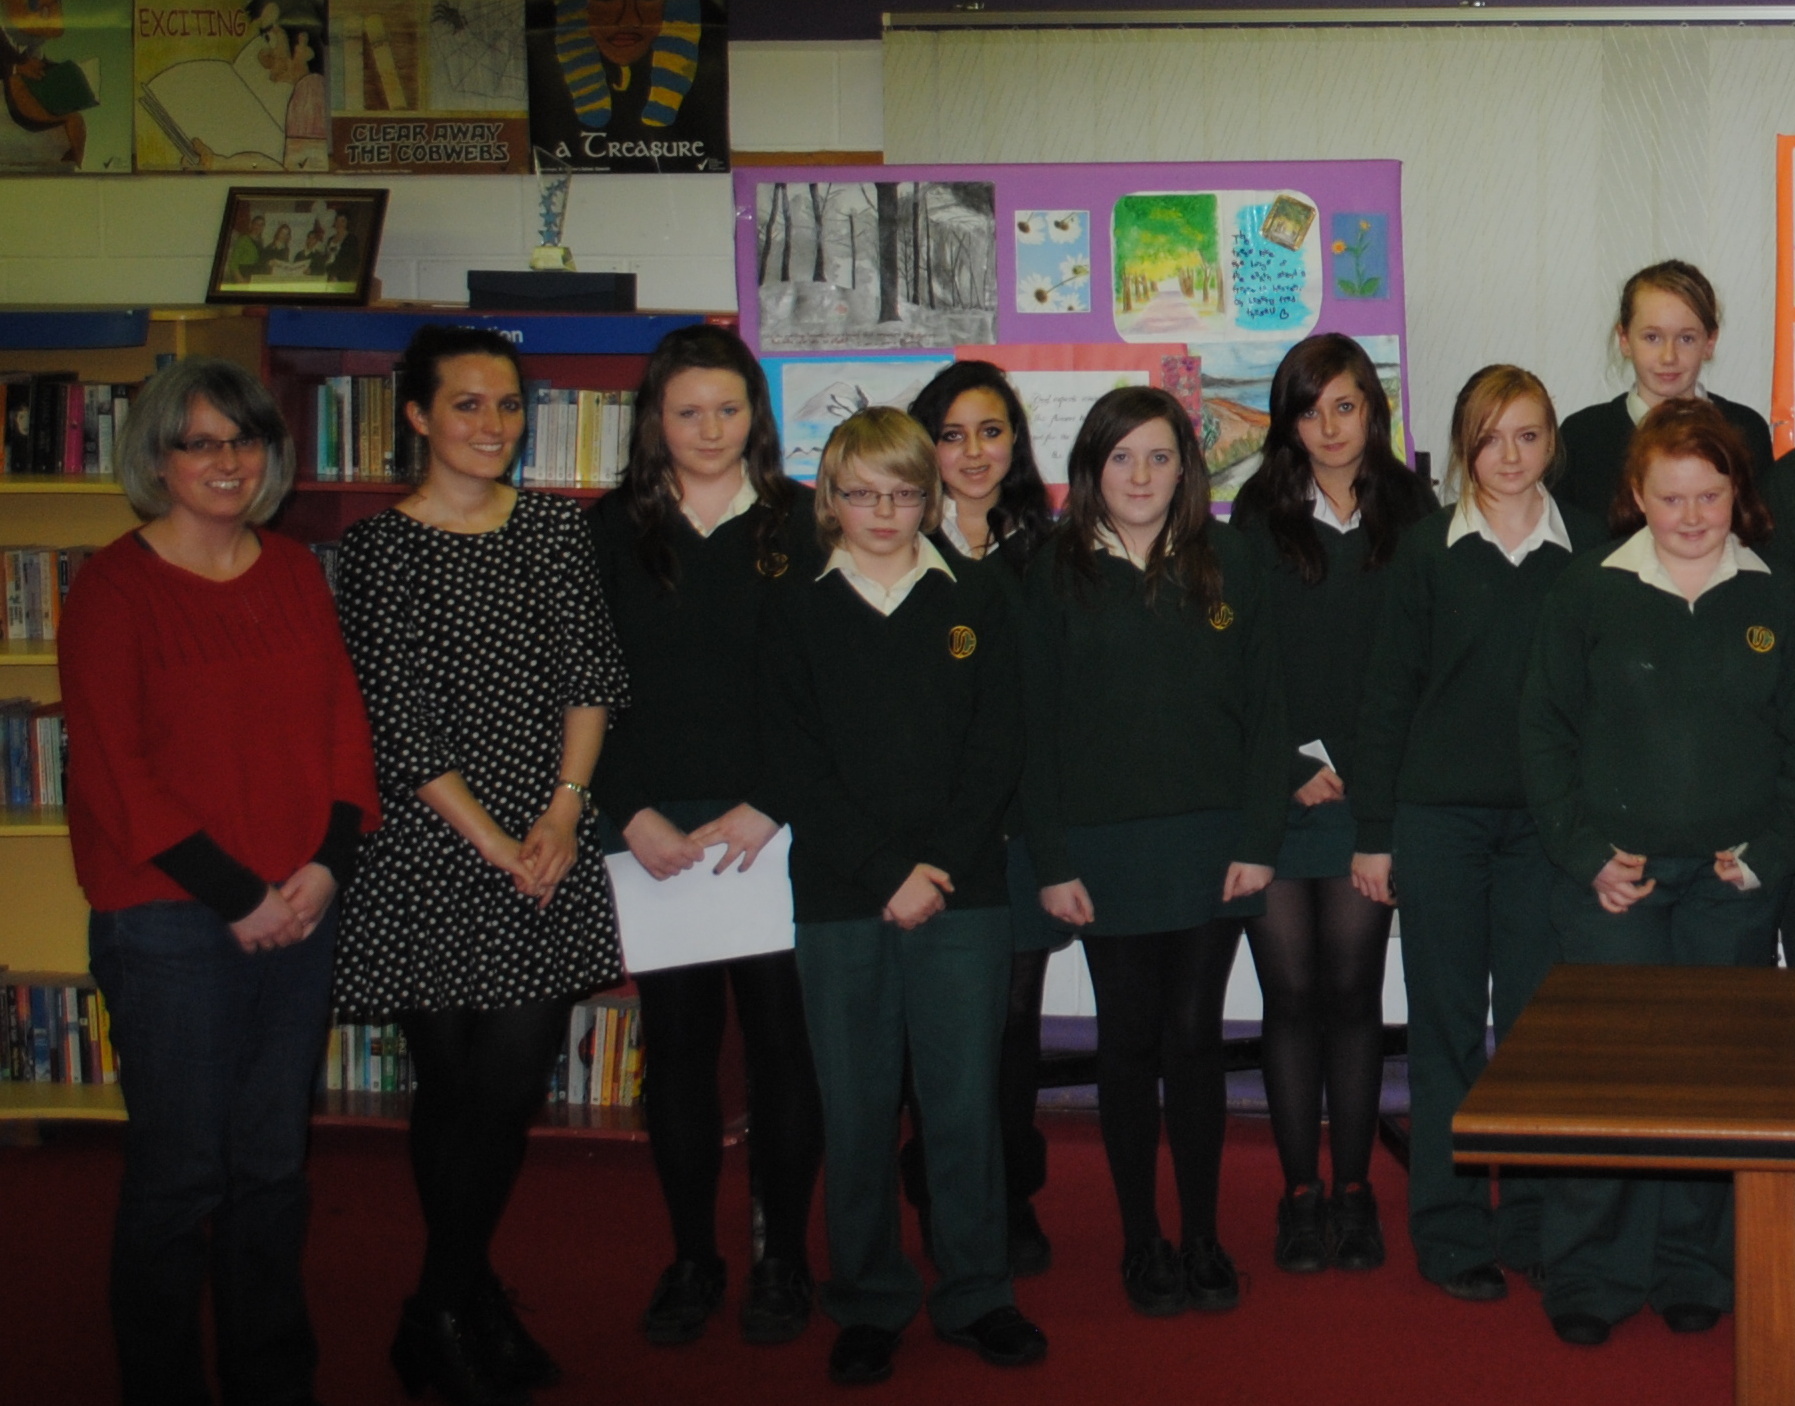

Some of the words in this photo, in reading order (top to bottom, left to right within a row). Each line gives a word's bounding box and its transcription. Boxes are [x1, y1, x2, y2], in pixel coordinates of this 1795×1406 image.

[139, 8, 247, 37] EXCITING
[352, 123, 428, 144] CLEAR
[432, 123, 503, 143] AWAY
[345, 143, 392, 163] THE
[397, 143, 510, 163] COBWEBS
